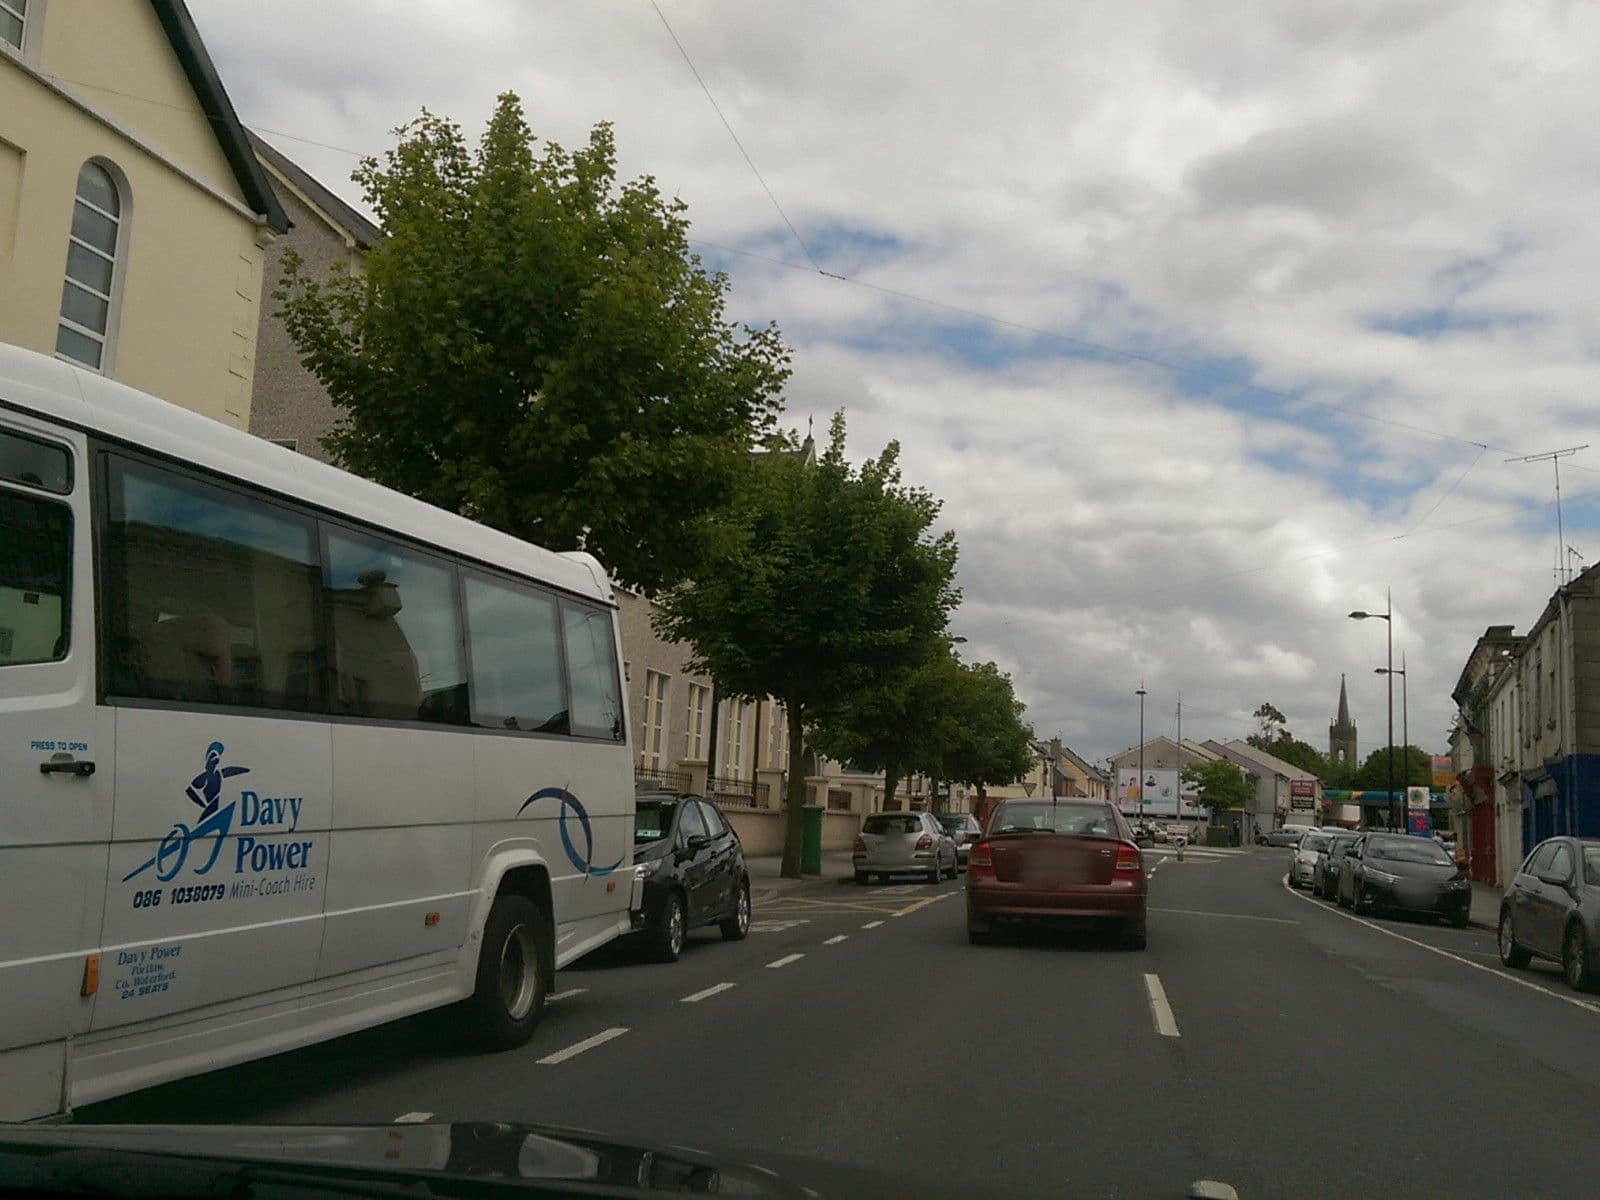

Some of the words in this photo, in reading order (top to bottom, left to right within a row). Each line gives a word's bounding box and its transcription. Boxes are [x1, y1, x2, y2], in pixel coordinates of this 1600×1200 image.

[31, 741, 55, 750] PRESS
[58, 742, 67, 750] TO
[69, 742, 88, 751] OPEN
[240, 791, 303, 833] Davy
[235, 837, 313, 875] Power
[133, 889, 162, 909] 086
[170, 883, 226, 905] 1038079
[229, 876, 290, 900] Mini-Coach
[293, 873, 316, 892] Hire
[118, 951, 146, 966] Davy
[151, 945, 182, 961] Power
[138, 982, 169, 996] SEATS
